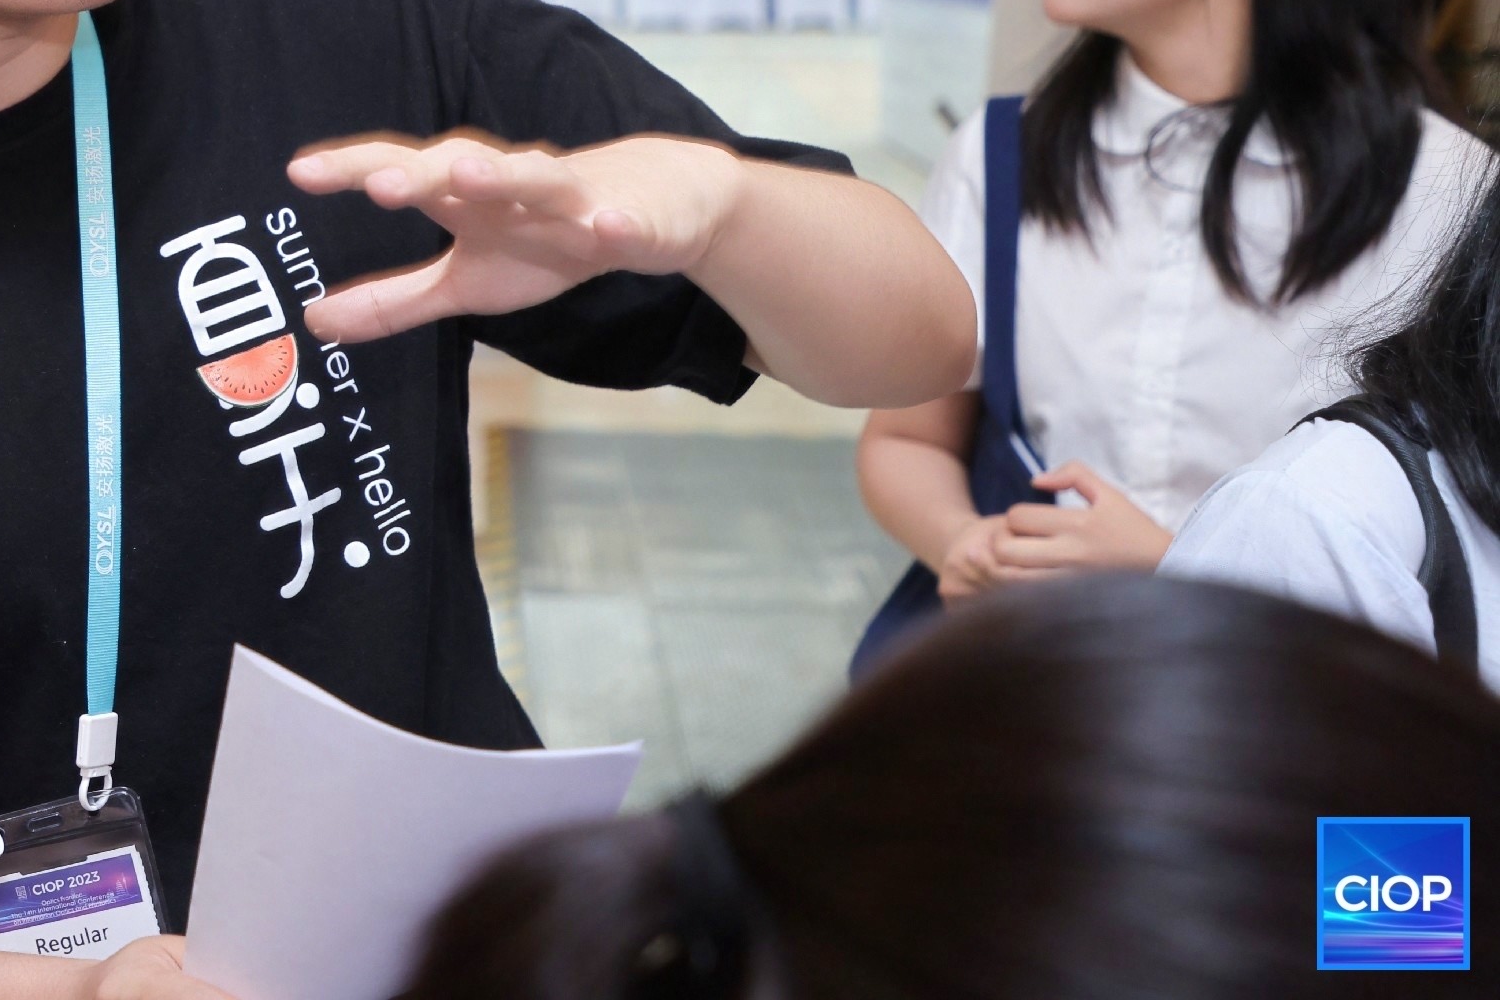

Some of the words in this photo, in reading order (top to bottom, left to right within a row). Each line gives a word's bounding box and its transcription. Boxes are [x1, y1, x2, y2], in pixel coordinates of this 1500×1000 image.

[266, 207, 360, 395] sumer
[343, 407, 372, 442] x
[354, 445, 412, 557] hello
[32, 879, 65, 896] CIOP
[68, 871, 101, 888] 2023
[35, 927, 109, 955] Regular
